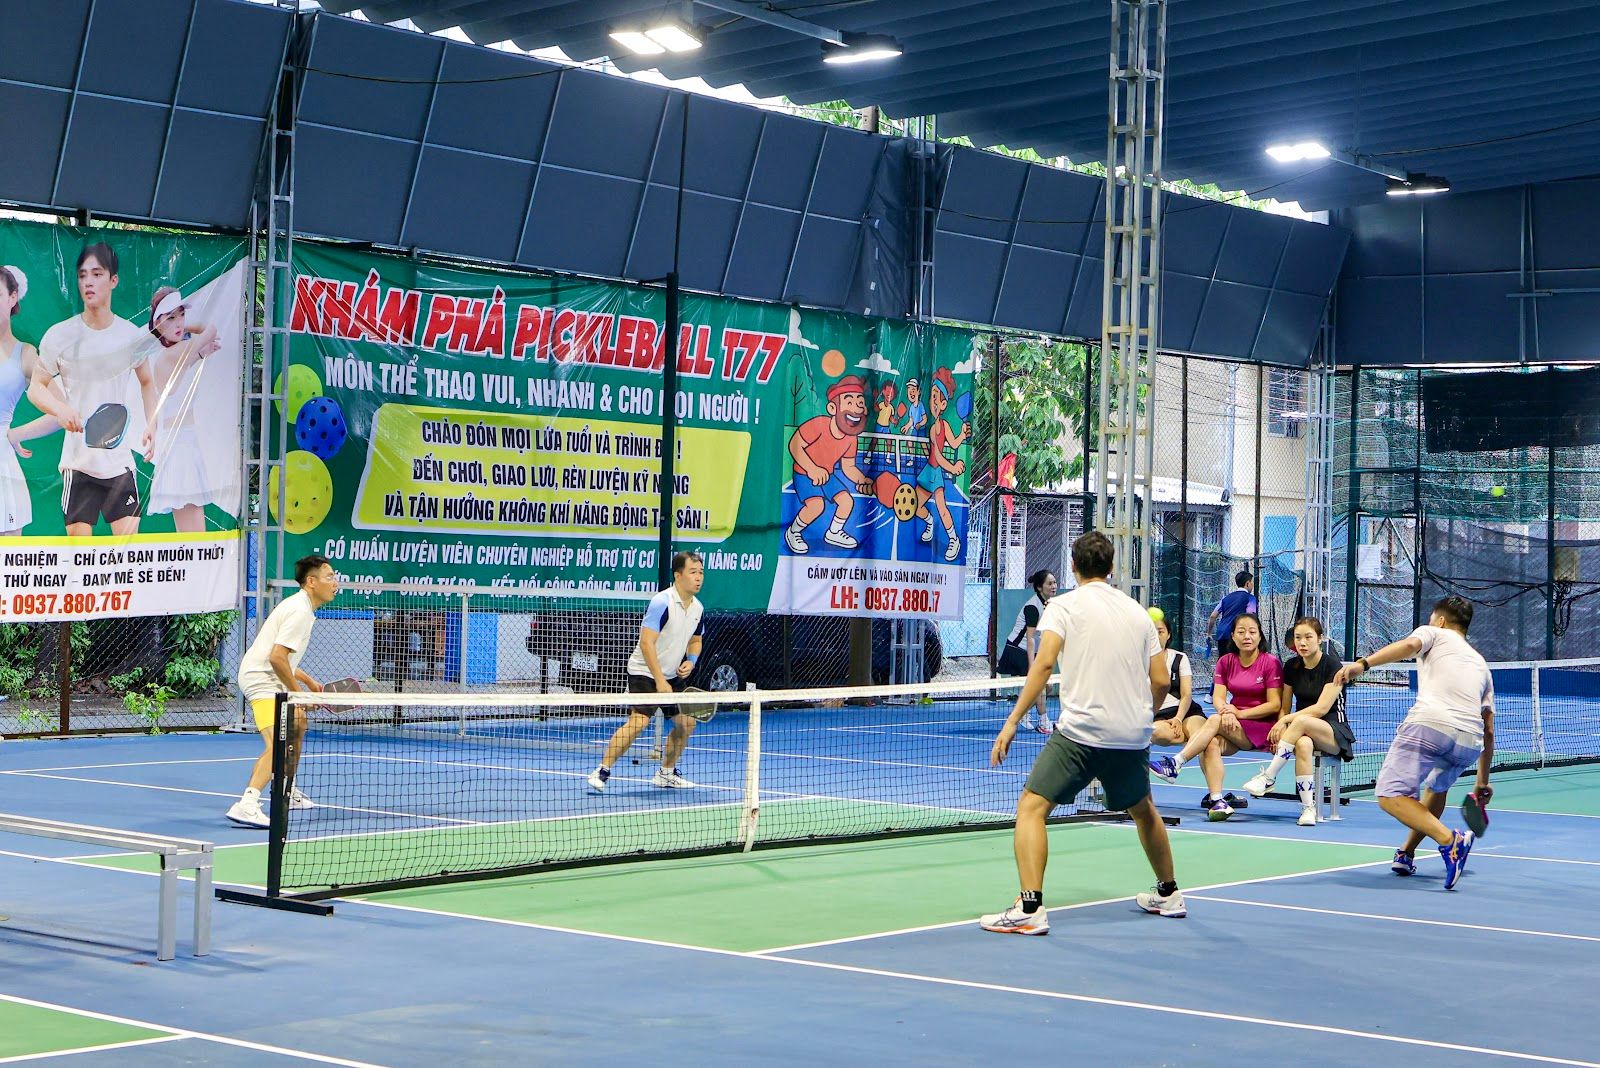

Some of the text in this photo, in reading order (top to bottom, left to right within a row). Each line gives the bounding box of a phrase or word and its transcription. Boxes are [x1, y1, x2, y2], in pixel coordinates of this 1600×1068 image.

[290, 268, 421, 347] KHÁM
[721, 327, 788, 384] T77
[325, 353, 373, 391] MÔN
[379, 354, 418, 396] THỂ
[424, 367, 475, 401] THAO
[482, 373, 521, 408] VUI,
[528, 378, 594, 410] NHANH
[600, 384, 613, 412] &
[618, 385, 653, 416] CHO
[659, 389, 693, 425] ỌI
[700, 390, 748, 424] NGƯỜI
[422, 418, 462, 445] CHÀO
[466, 421, 497, 447] ĐÓN
[502, 427, 531, 454] MỌI
[567, 425, 591, 453] TUỔI
[595, 430, 611, 455] VÀ
[615, 432, 651, 458] TRÌNH
[413, 453, 689, 495] ĐẾN CHƠI, GIAO LƯU, RÈN LUYỆN KỸ NNG
[385, 491, 404, 517] VÀ
[409, 492, 438, 523] TẬN
[443, 492, 494, 521] HƯỞNG
[499, 498, 546, 524] KHÔNG
[550, 499, 569, 524] KHÍ
[574, 500, 608, 526] NĂNG
[613, 503, 647, 530] ĐỘNG
[676, 506, 701, 529] SÂN
[4, 551, 58, 569] NGHIỆM
[74, 549, 96, 566] CHỈ
[128, 549, 153, 565] BẠN
[158, 545, 193, 562] MUỐN
[198, 544, 224, 560] THỬ!
[324, 535, 346, 560] CÓ
[350, 534, 388, 561] HUẤN
[393, 539, 438, 567] LUYỆN
[442, 541, 473, 564] VIÊN
[476, 542, 528, 566] CHUYÊN
[531, 544, 574, 570] NGHIỆP
[576, 542, 593, 567] HỖ
[596, 548, 619, 571] TRỢ
[622, 546, 637, 569] TỪ
[638, 549, 655, 568] CƠ
[708, 548, 737, 570] NÂNG
[740, 553, 763, 571] CAO
[4, 570, 30, 587] THỬ
[33, 574, 67, 587] NGAY
[83, 573, 112, 587] ĐAM
[114, 569, 134, 584] MÊ
[138, 568, 153, 583] SẼ
[157, 566, 186, 582] ĐẾN!
[850, 566, 867, 580] LÊN
[910, 571, 929, 584] NGAY
[13, 590, 132, 615] 0937.880.767
[831, 585, 859, 609] LH:
